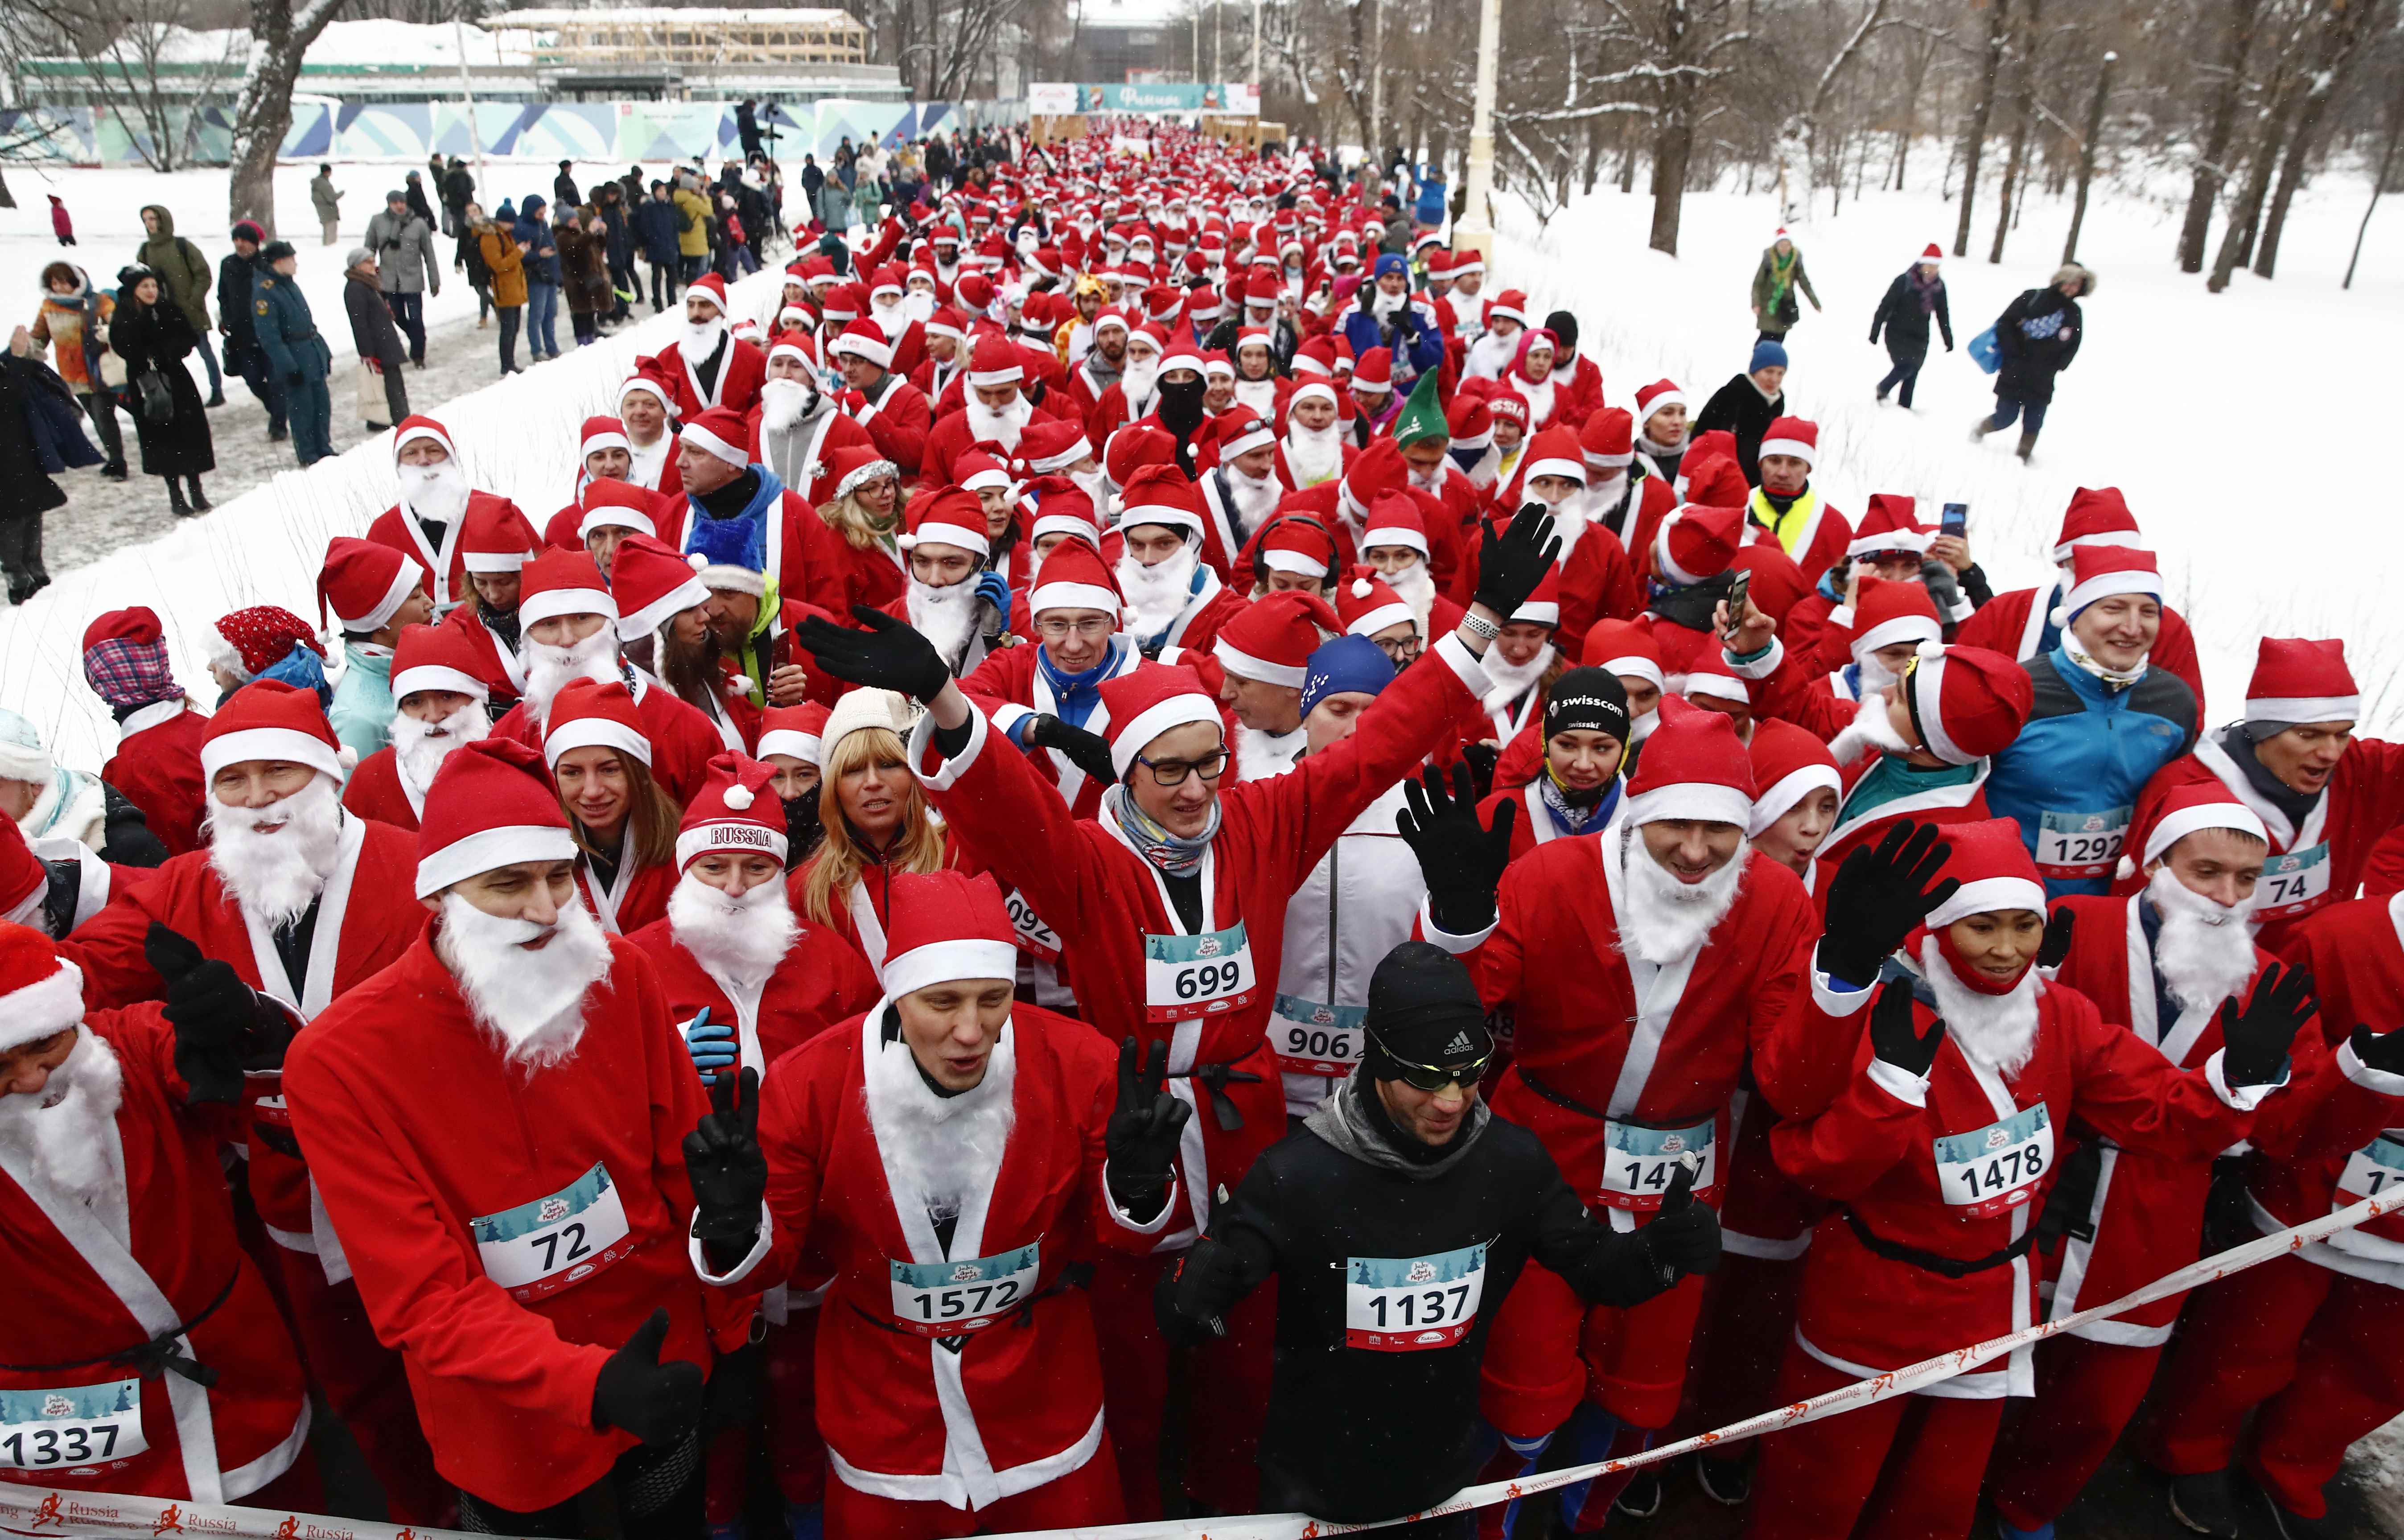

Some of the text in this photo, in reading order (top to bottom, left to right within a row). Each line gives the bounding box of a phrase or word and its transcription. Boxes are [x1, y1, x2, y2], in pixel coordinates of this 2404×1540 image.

[1562, 695, 1622, 717] swisscom
[1567, 721, 1600, 729] swissski
[711, 828, 771, 847] RUSSIA
[2055, 835, 2123, 856] 1292
[2270, 875, 2307, 903] 74
[1176, 961, 1239, 998] 699
[1288, 1028, 1350, 1058] 906
[1444, 1044, 1474, 1055] adidas
[1625, 1156, 1706, 1190] 147
[1961, 1144, 2042, 1197] 1478
[2367, 1171, 2404, 1195] 1
[531, 1223, 591, 1271] 72
[571, 1266, 592, 1279] Takeda
[914, 1281, 1019, 1318] 1572
[1369, 1285, 1469, 1326] 1137
[1979, 1329, 2027, 1351] Running
[1896, 1356, 1946, 1380] Running
[1811, 1386, 1860, 1409] Running
[1722, 1417, 1773, 1438] Running
[3, 1425, 119, 1466] 1337
[70, 1502, 119, 1518] Russia
[1430, 1500, 1473, 1516] Russia
[189, 1514, 236, 1531] Russia
[306, 1524, 354, 1540] Russia
